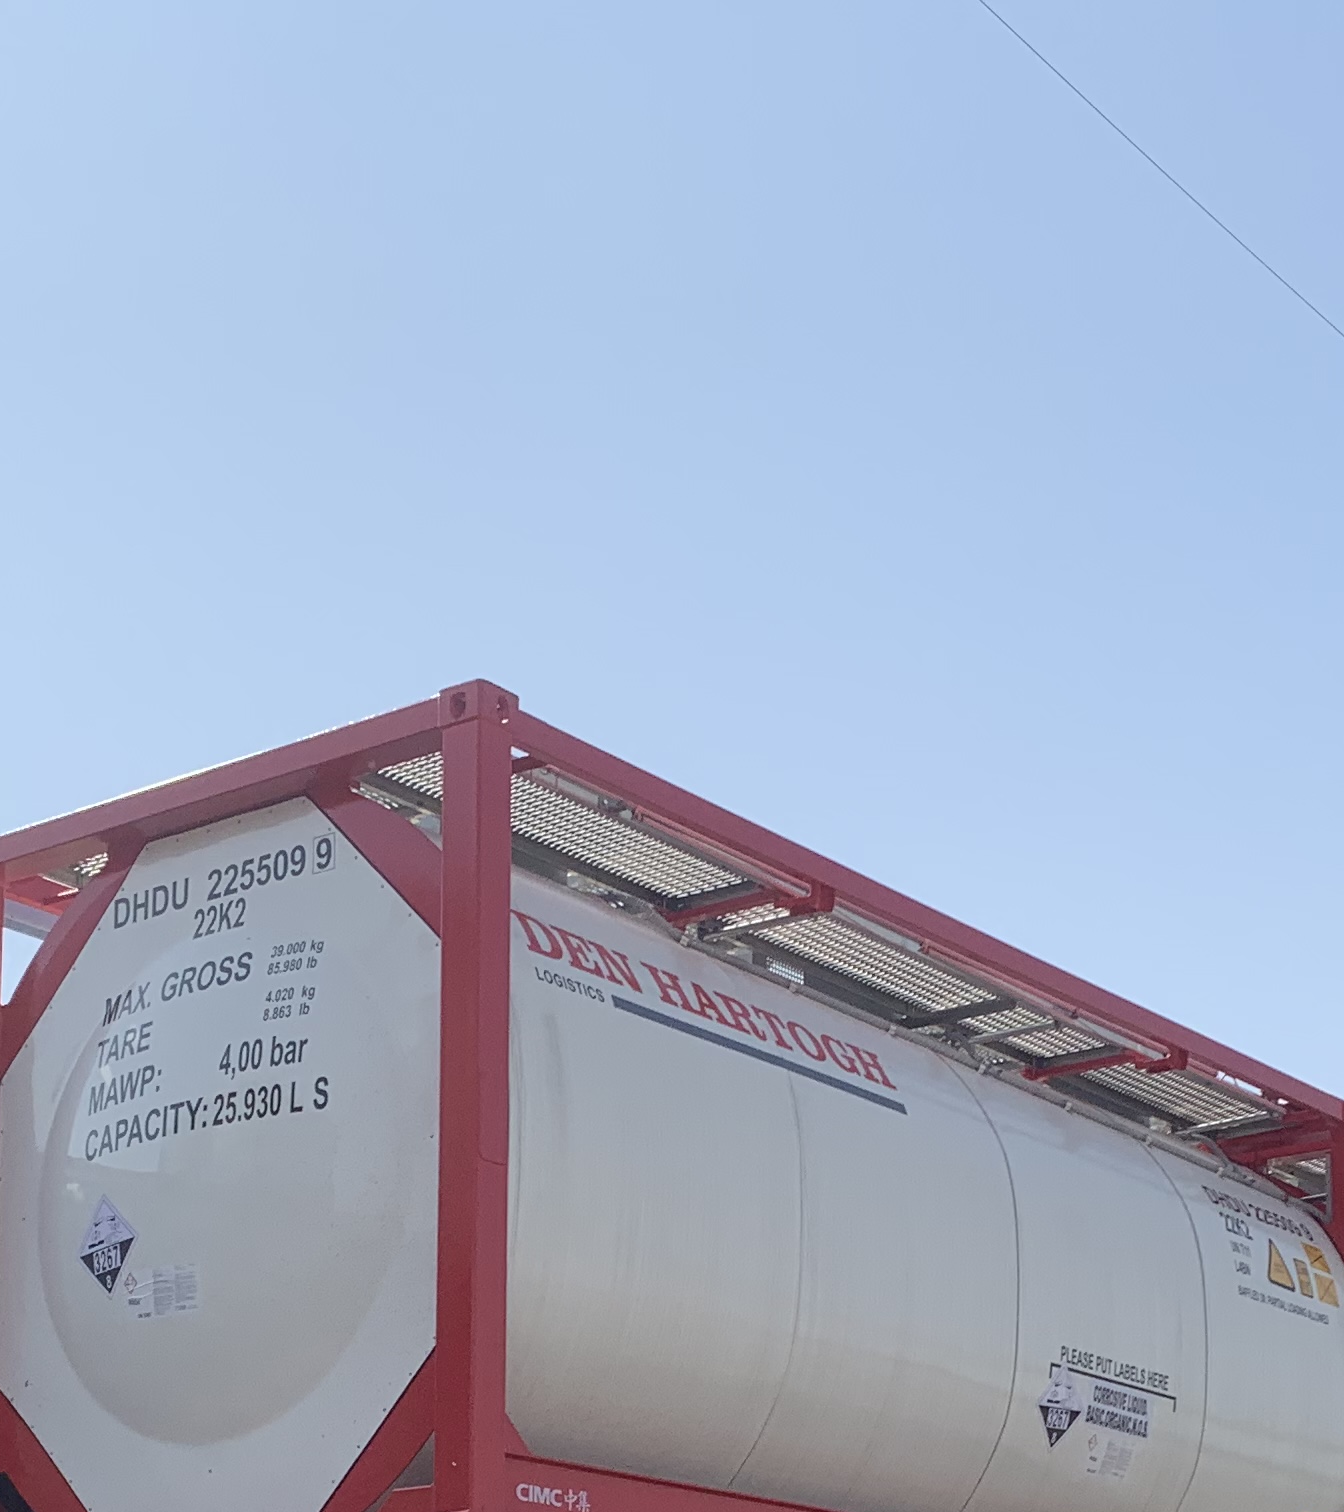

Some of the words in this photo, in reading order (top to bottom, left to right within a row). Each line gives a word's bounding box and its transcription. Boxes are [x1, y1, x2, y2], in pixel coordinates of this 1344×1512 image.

[113, 878, 190, 930] DHDU
[207, 845, 307, 900] 225509
[315, 837, 333, 870] 9
[193, 897, 247, 940] 22K2
[267, 959, 303, 976] 85.980
[306, 956, 318, 969] lb
[270, 941, 307, 959] 39.000
[309, 939, 325, 953] kg
[102, 981, 152, 1027] MAX.
[160, 951, 254, 1002] GROSS
[265, 988, 295, 1004] 4.020
[301, 985, 316, 1001] kg
[510, 909, 643, 993] DEN
[640, 961, 898, 1091] HARTOGH
[534, 966, 605, 1003] LOGISTICS
[262, 1005, 292, 1021] 8.863
[299, 1003, 311, 1016] lb
[97, 1021, 154, 1069] TARE
[88, 1064, 162, 1116] MAWP:
[270, 1036, 309, 1067] bar
[84, 1096, 208, 1161] CAPACITY:
[212, 1084, 282, 1126] 25.930
[290, 1082, 304, 1112] L
[313, 1076, 330, 1110] S
[94, 1246, 121, 1274] 3267
[106, 1275, 112, 1289] 8
[1060, 1345, 1094, 1370] PLEASE
[1096, 1356, 1113, 1374] PUT
[1114, 1361, 1146, 1385] LABELS
[1147, 1368, 1169, 1391] HERE
[516, 1483, 563, 1508] CIMC
